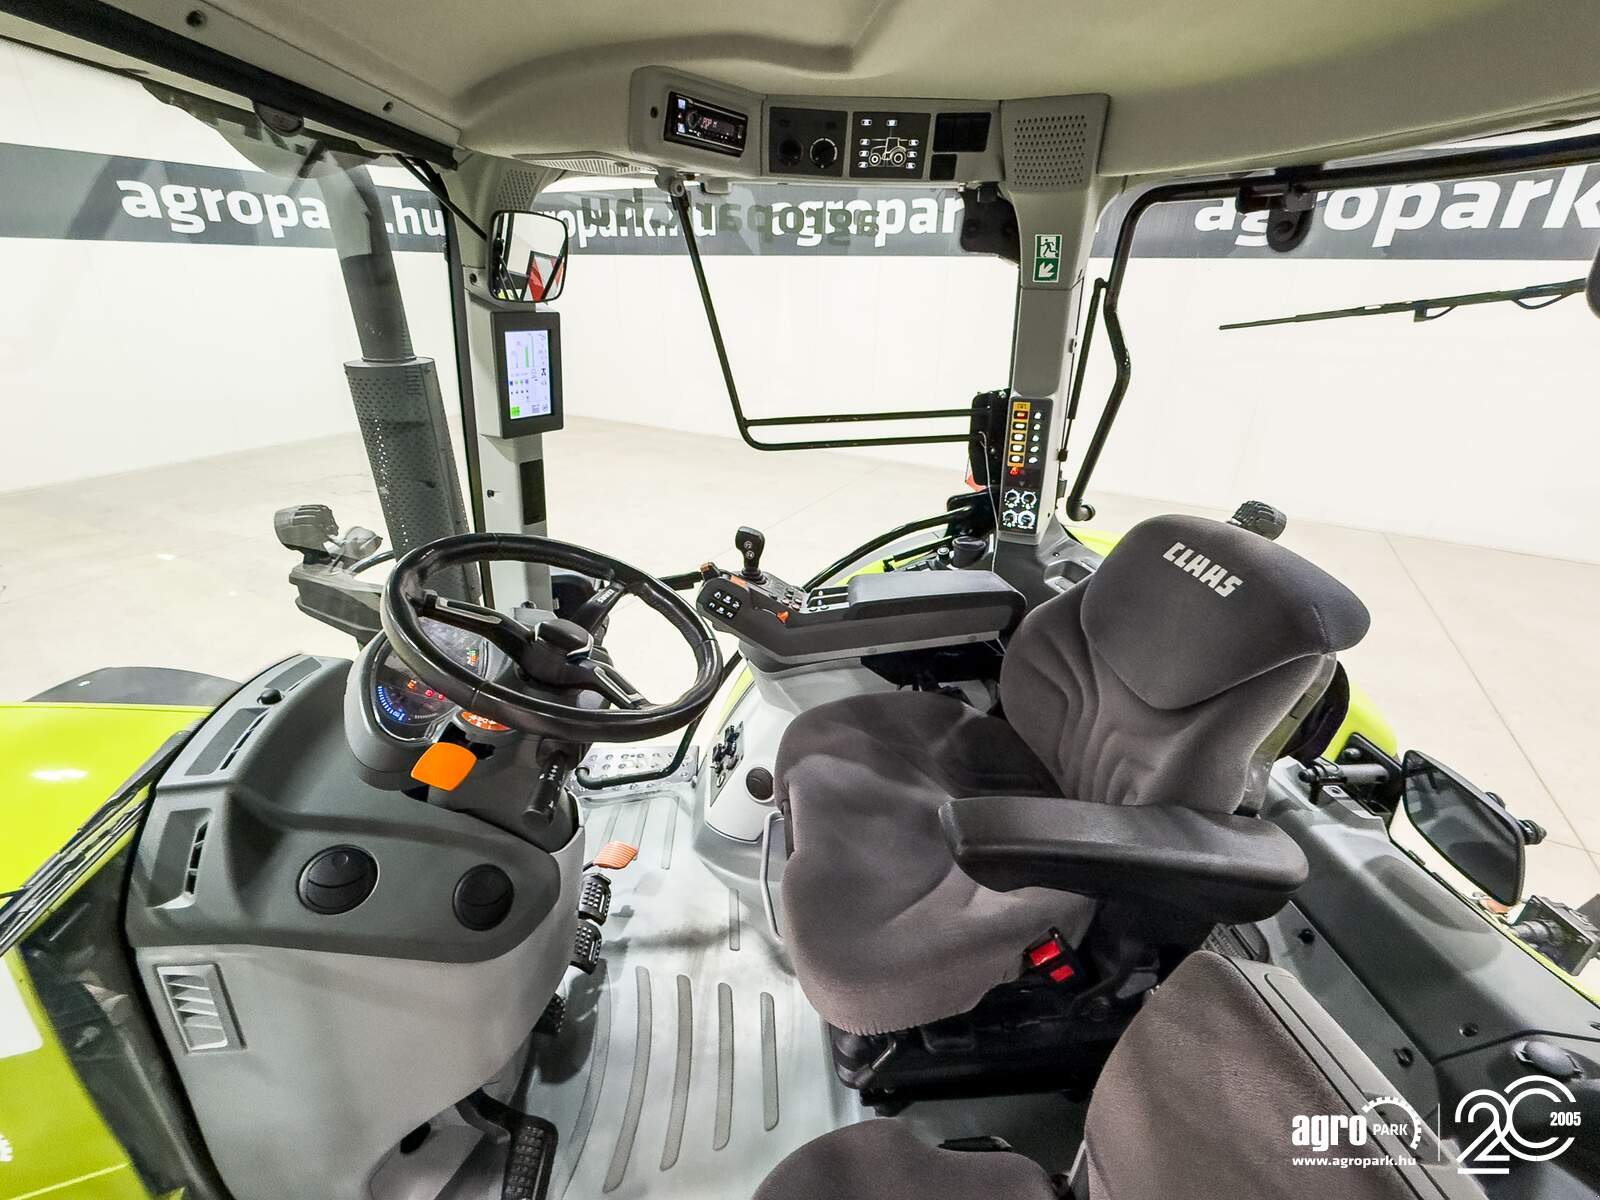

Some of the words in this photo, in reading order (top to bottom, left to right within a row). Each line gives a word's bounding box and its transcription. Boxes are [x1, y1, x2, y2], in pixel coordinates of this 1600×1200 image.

[116, 180, 446, 238] agropa.hu
[771, 197, 965, 248] agropar
[1162, 541, 1244, 598] CLAAS
